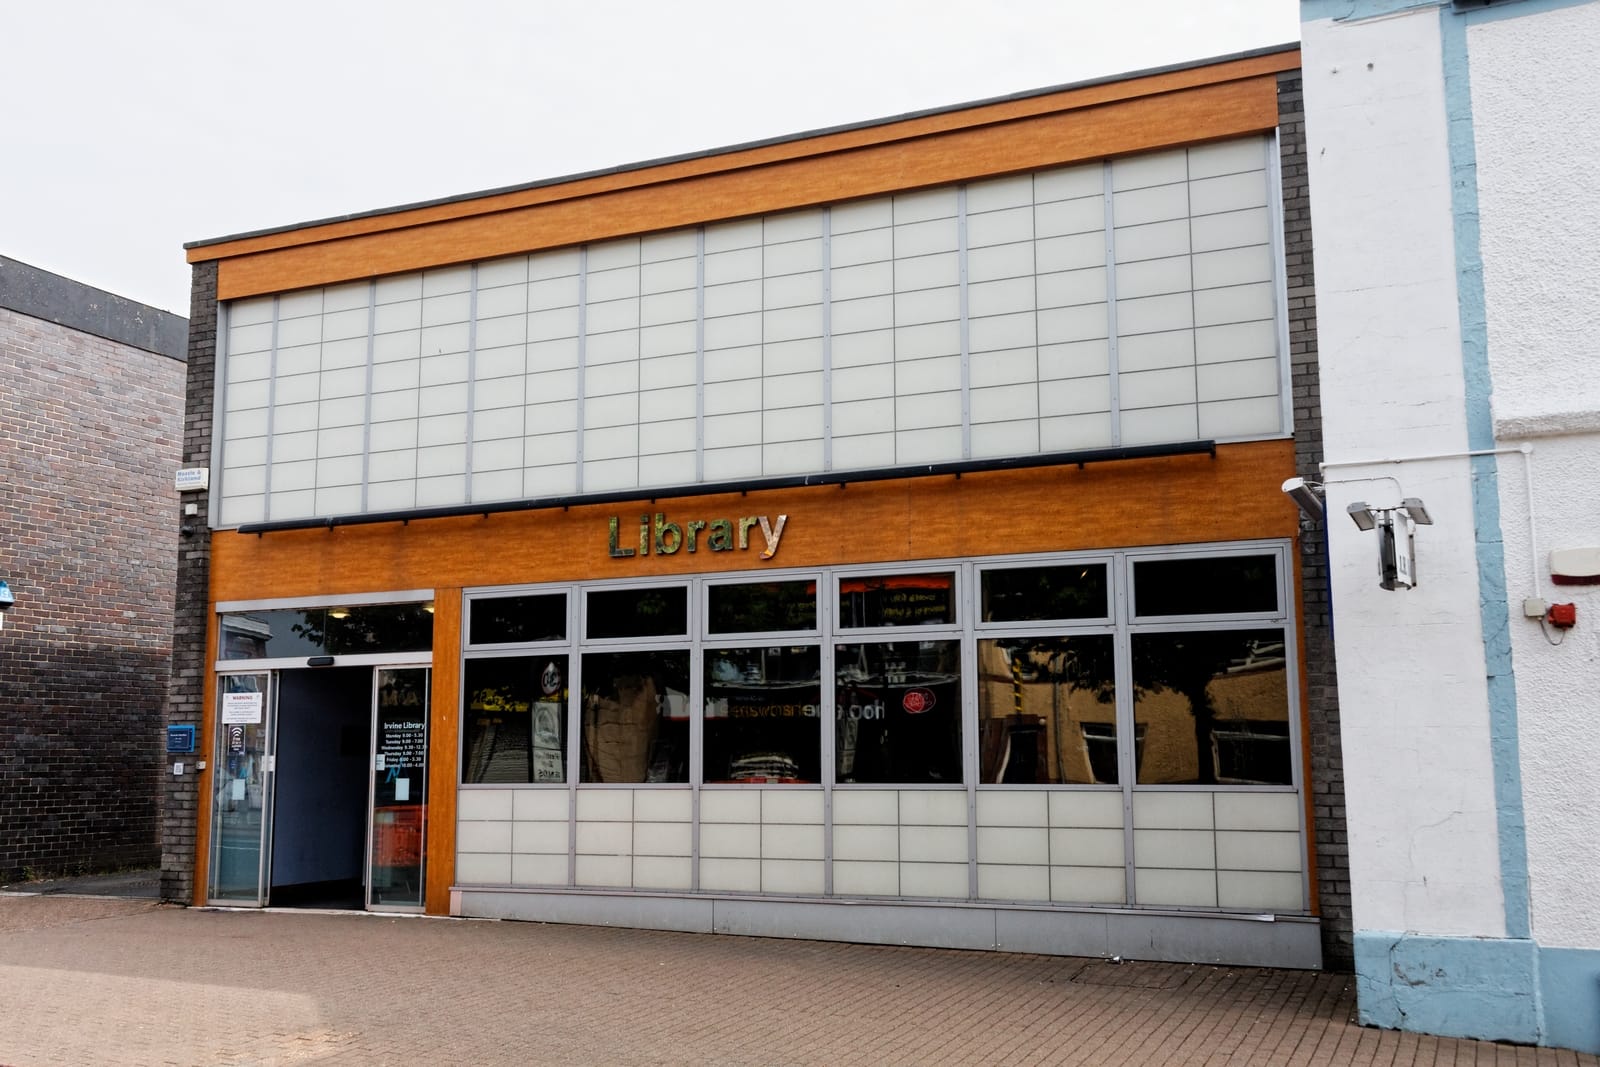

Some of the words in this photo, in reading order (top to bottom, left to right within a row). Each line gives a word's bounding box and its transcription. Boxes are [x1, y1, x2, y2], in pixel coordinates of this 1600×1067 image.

[608, 513, 787, 560] Library
[384, 722, 402, 730] Irvine
[403, 722, 425, 730] Library
